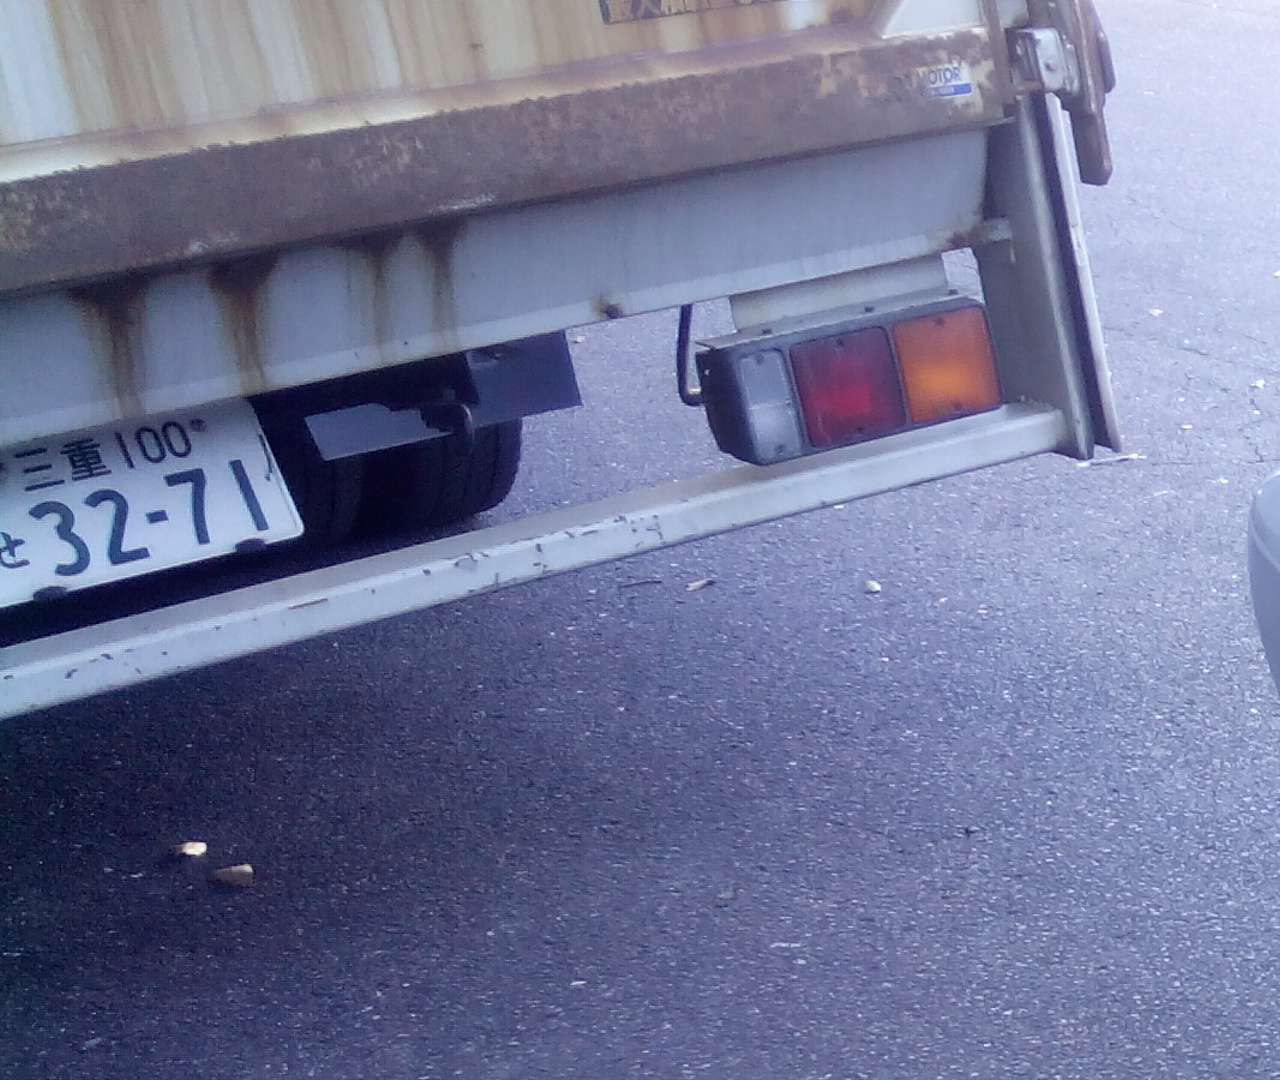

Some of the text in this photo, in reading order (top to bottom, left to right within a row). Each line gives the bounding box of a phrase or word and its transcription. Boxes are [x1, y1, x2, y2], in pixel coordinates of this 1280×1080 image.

[13, 420, 192, 492] 三重 100
[28, 459, 269, 577] 32-71
